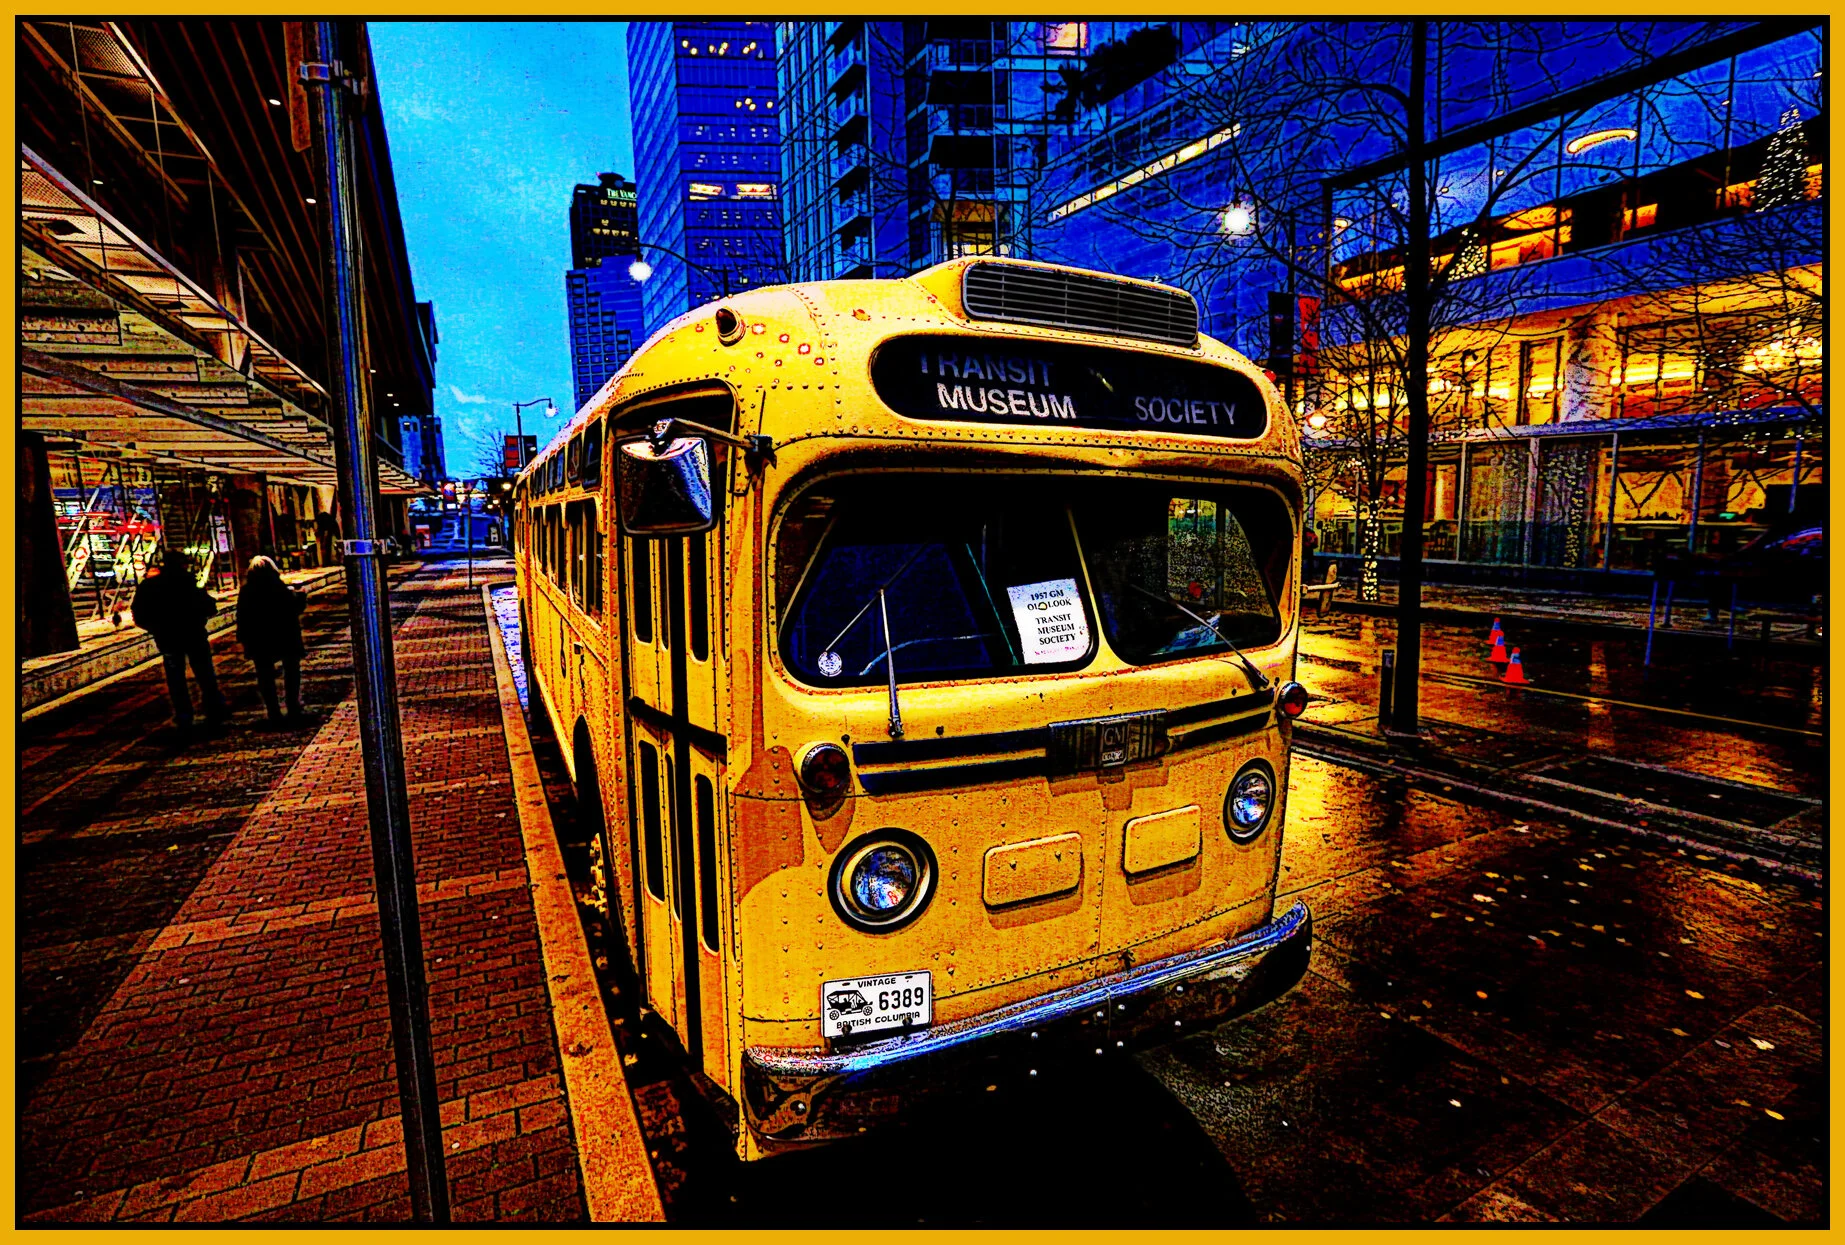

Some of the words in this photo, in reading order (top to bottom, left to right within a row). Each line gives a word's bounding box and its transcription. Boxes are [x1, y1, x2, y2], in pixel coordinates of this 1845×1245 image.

[920, 352, 1054, 387] TRANSIT
[936, 383, 1078, 420] MUSEUM
[1134, 395, 1237, 425] SOCIETY
[1030, 591, 1048, 601] 1957
[1049, 589, 1065, 598] GM
[1047, 598, 1072, 608] LOOK
[1035, 613, 1071, 625] TRANSIT
[1037, 623, 1075, 635] MUSEUM
[1039, 633, 1076, 645] SOCIETY
[857, 977, 897, 988] VINTAGE
[878, 987, 924, 1011] 6389
